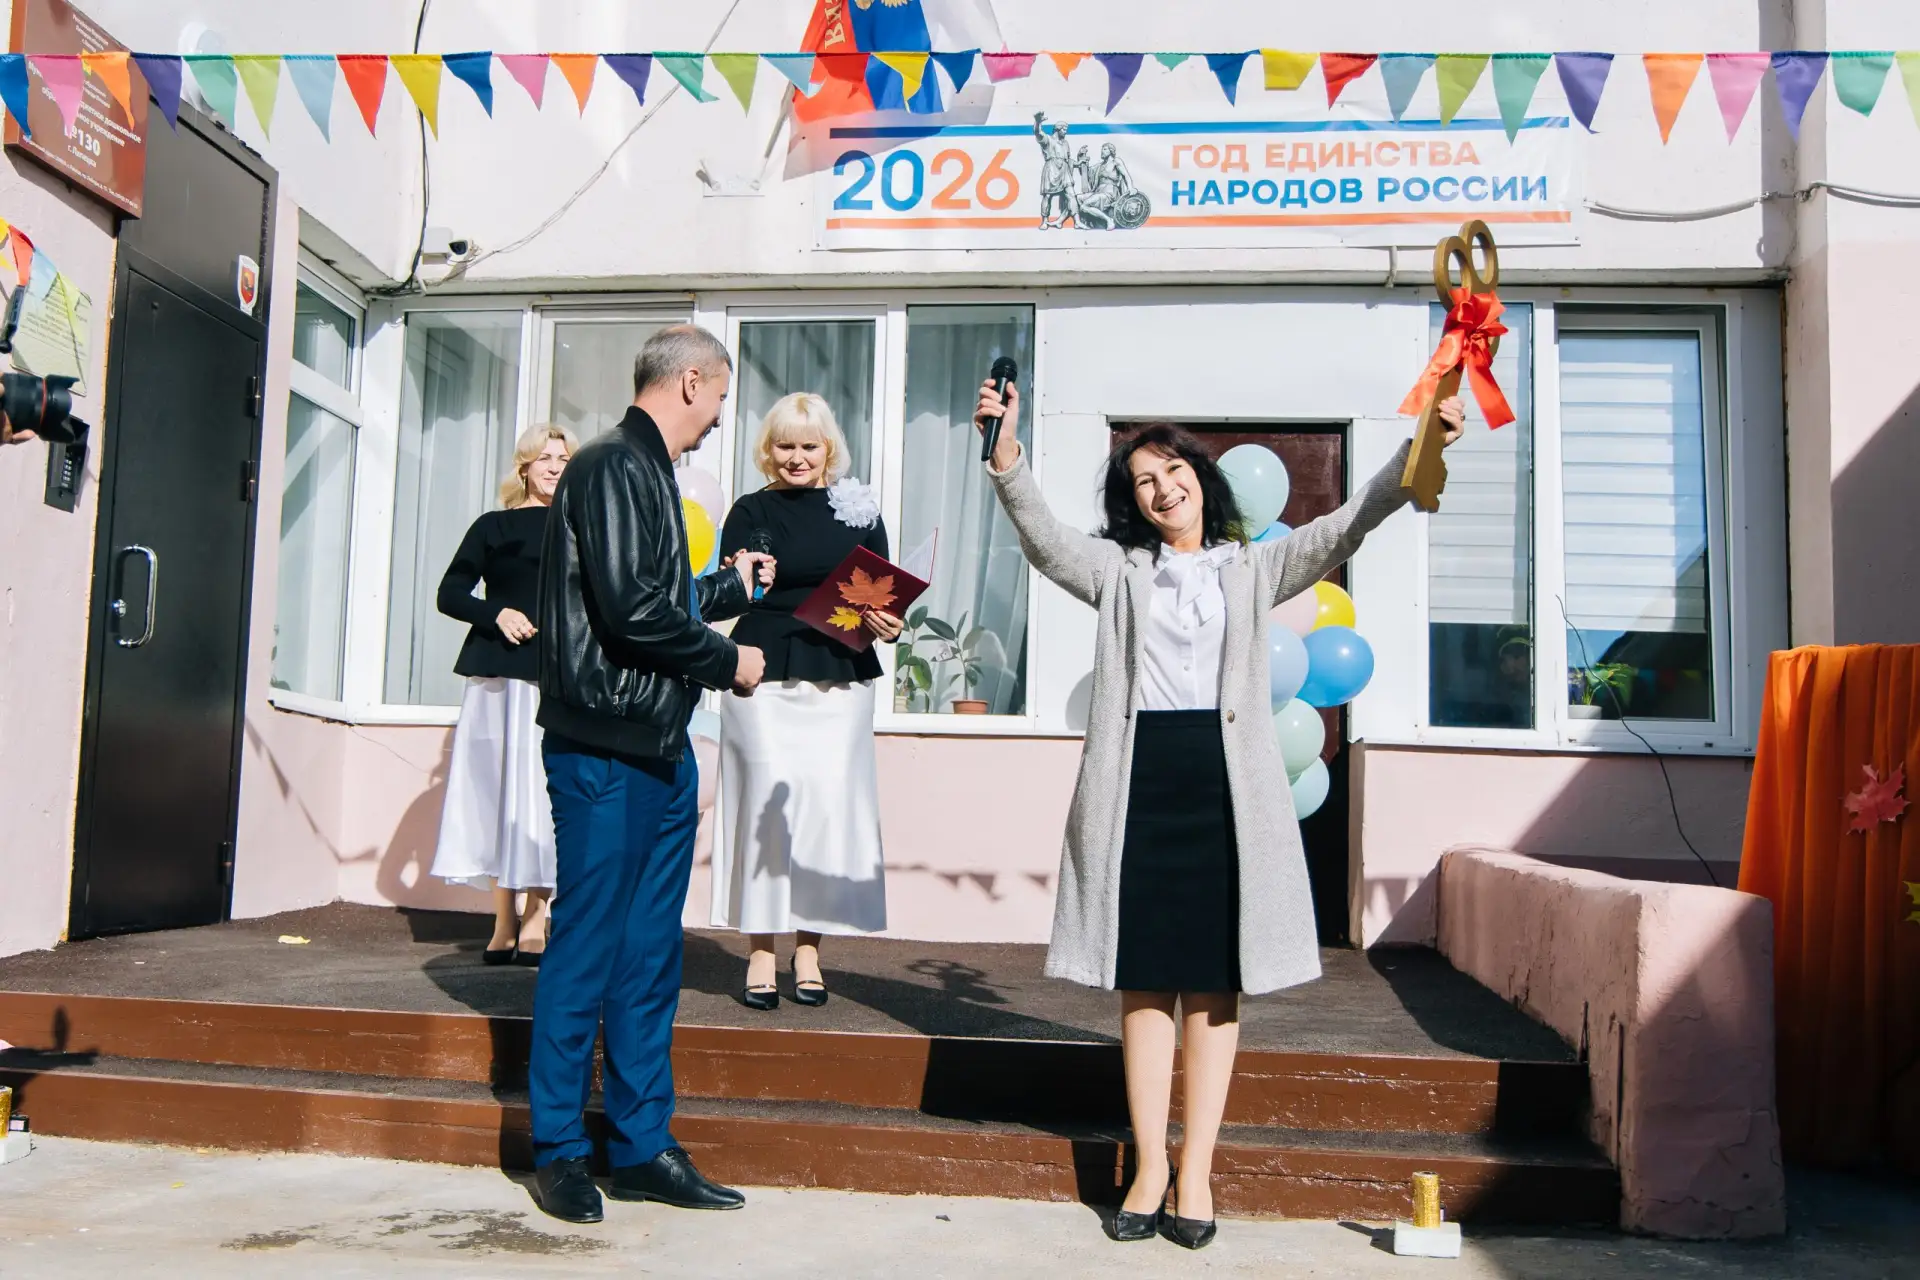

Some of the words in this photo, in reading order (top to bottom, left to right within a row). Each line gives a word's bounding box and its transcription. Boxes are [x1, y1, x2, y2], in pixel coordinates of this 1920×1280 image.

[1172, 143, 1249, 173] ГОД
[1265, 140, 1479, 172] ЕДИНСТВА
[833, 149, 1020, 211] 2026
[1171, 178, 1362, 208] НАРОДОВ
[1378, 175, 1548, 203] РОССИИ
